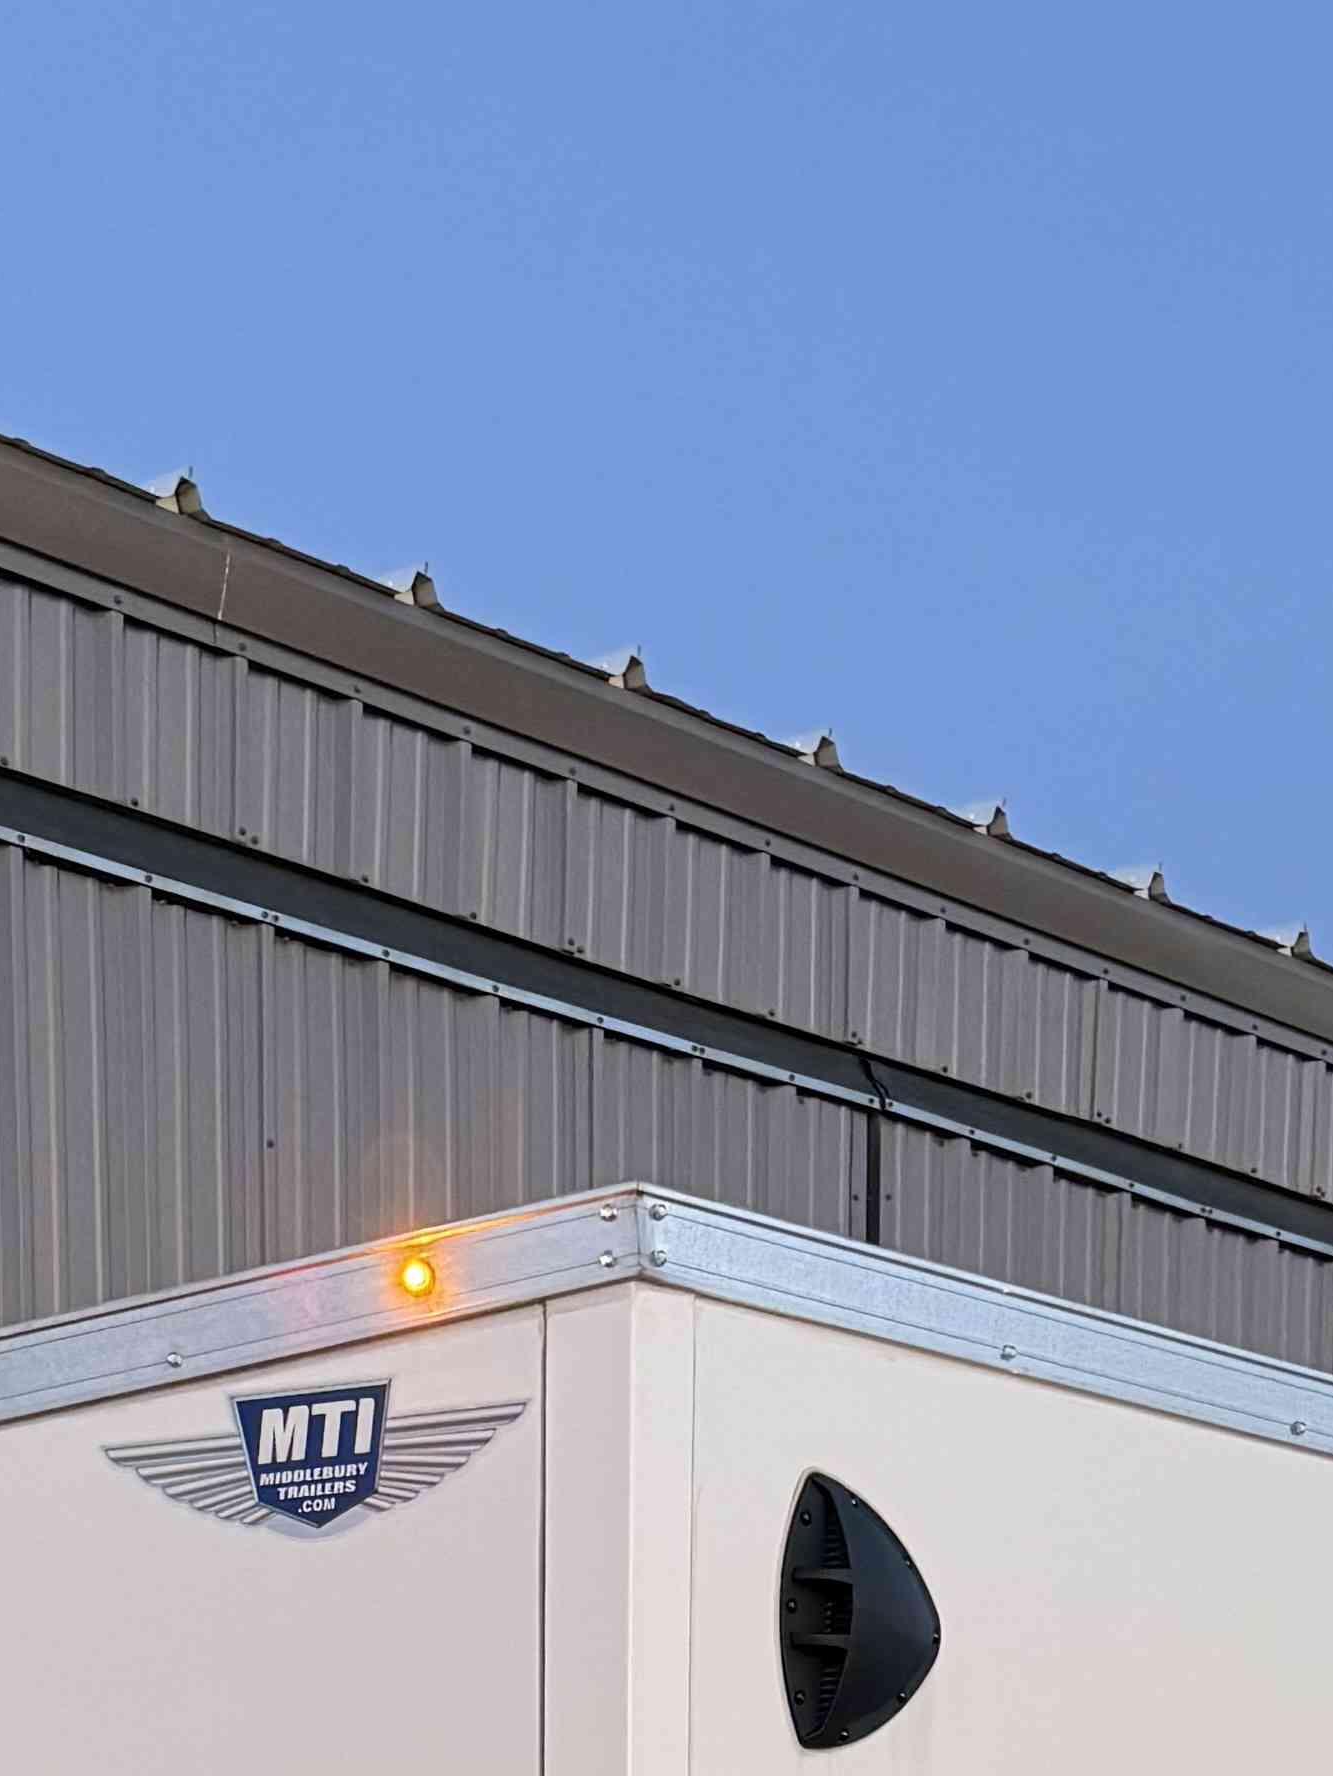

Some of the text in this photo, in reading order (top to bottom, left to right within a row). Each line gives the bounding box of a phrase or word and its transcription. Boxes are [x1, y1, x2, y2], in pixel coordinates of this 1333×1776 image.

[258, 1397, 375, 1465] MTI
[259, 1462, 369, 1486] MIDDLEBURY
[277, 1480, 357, 1500] TRAILERS
[297, 1497, 336, 1513] .COM
